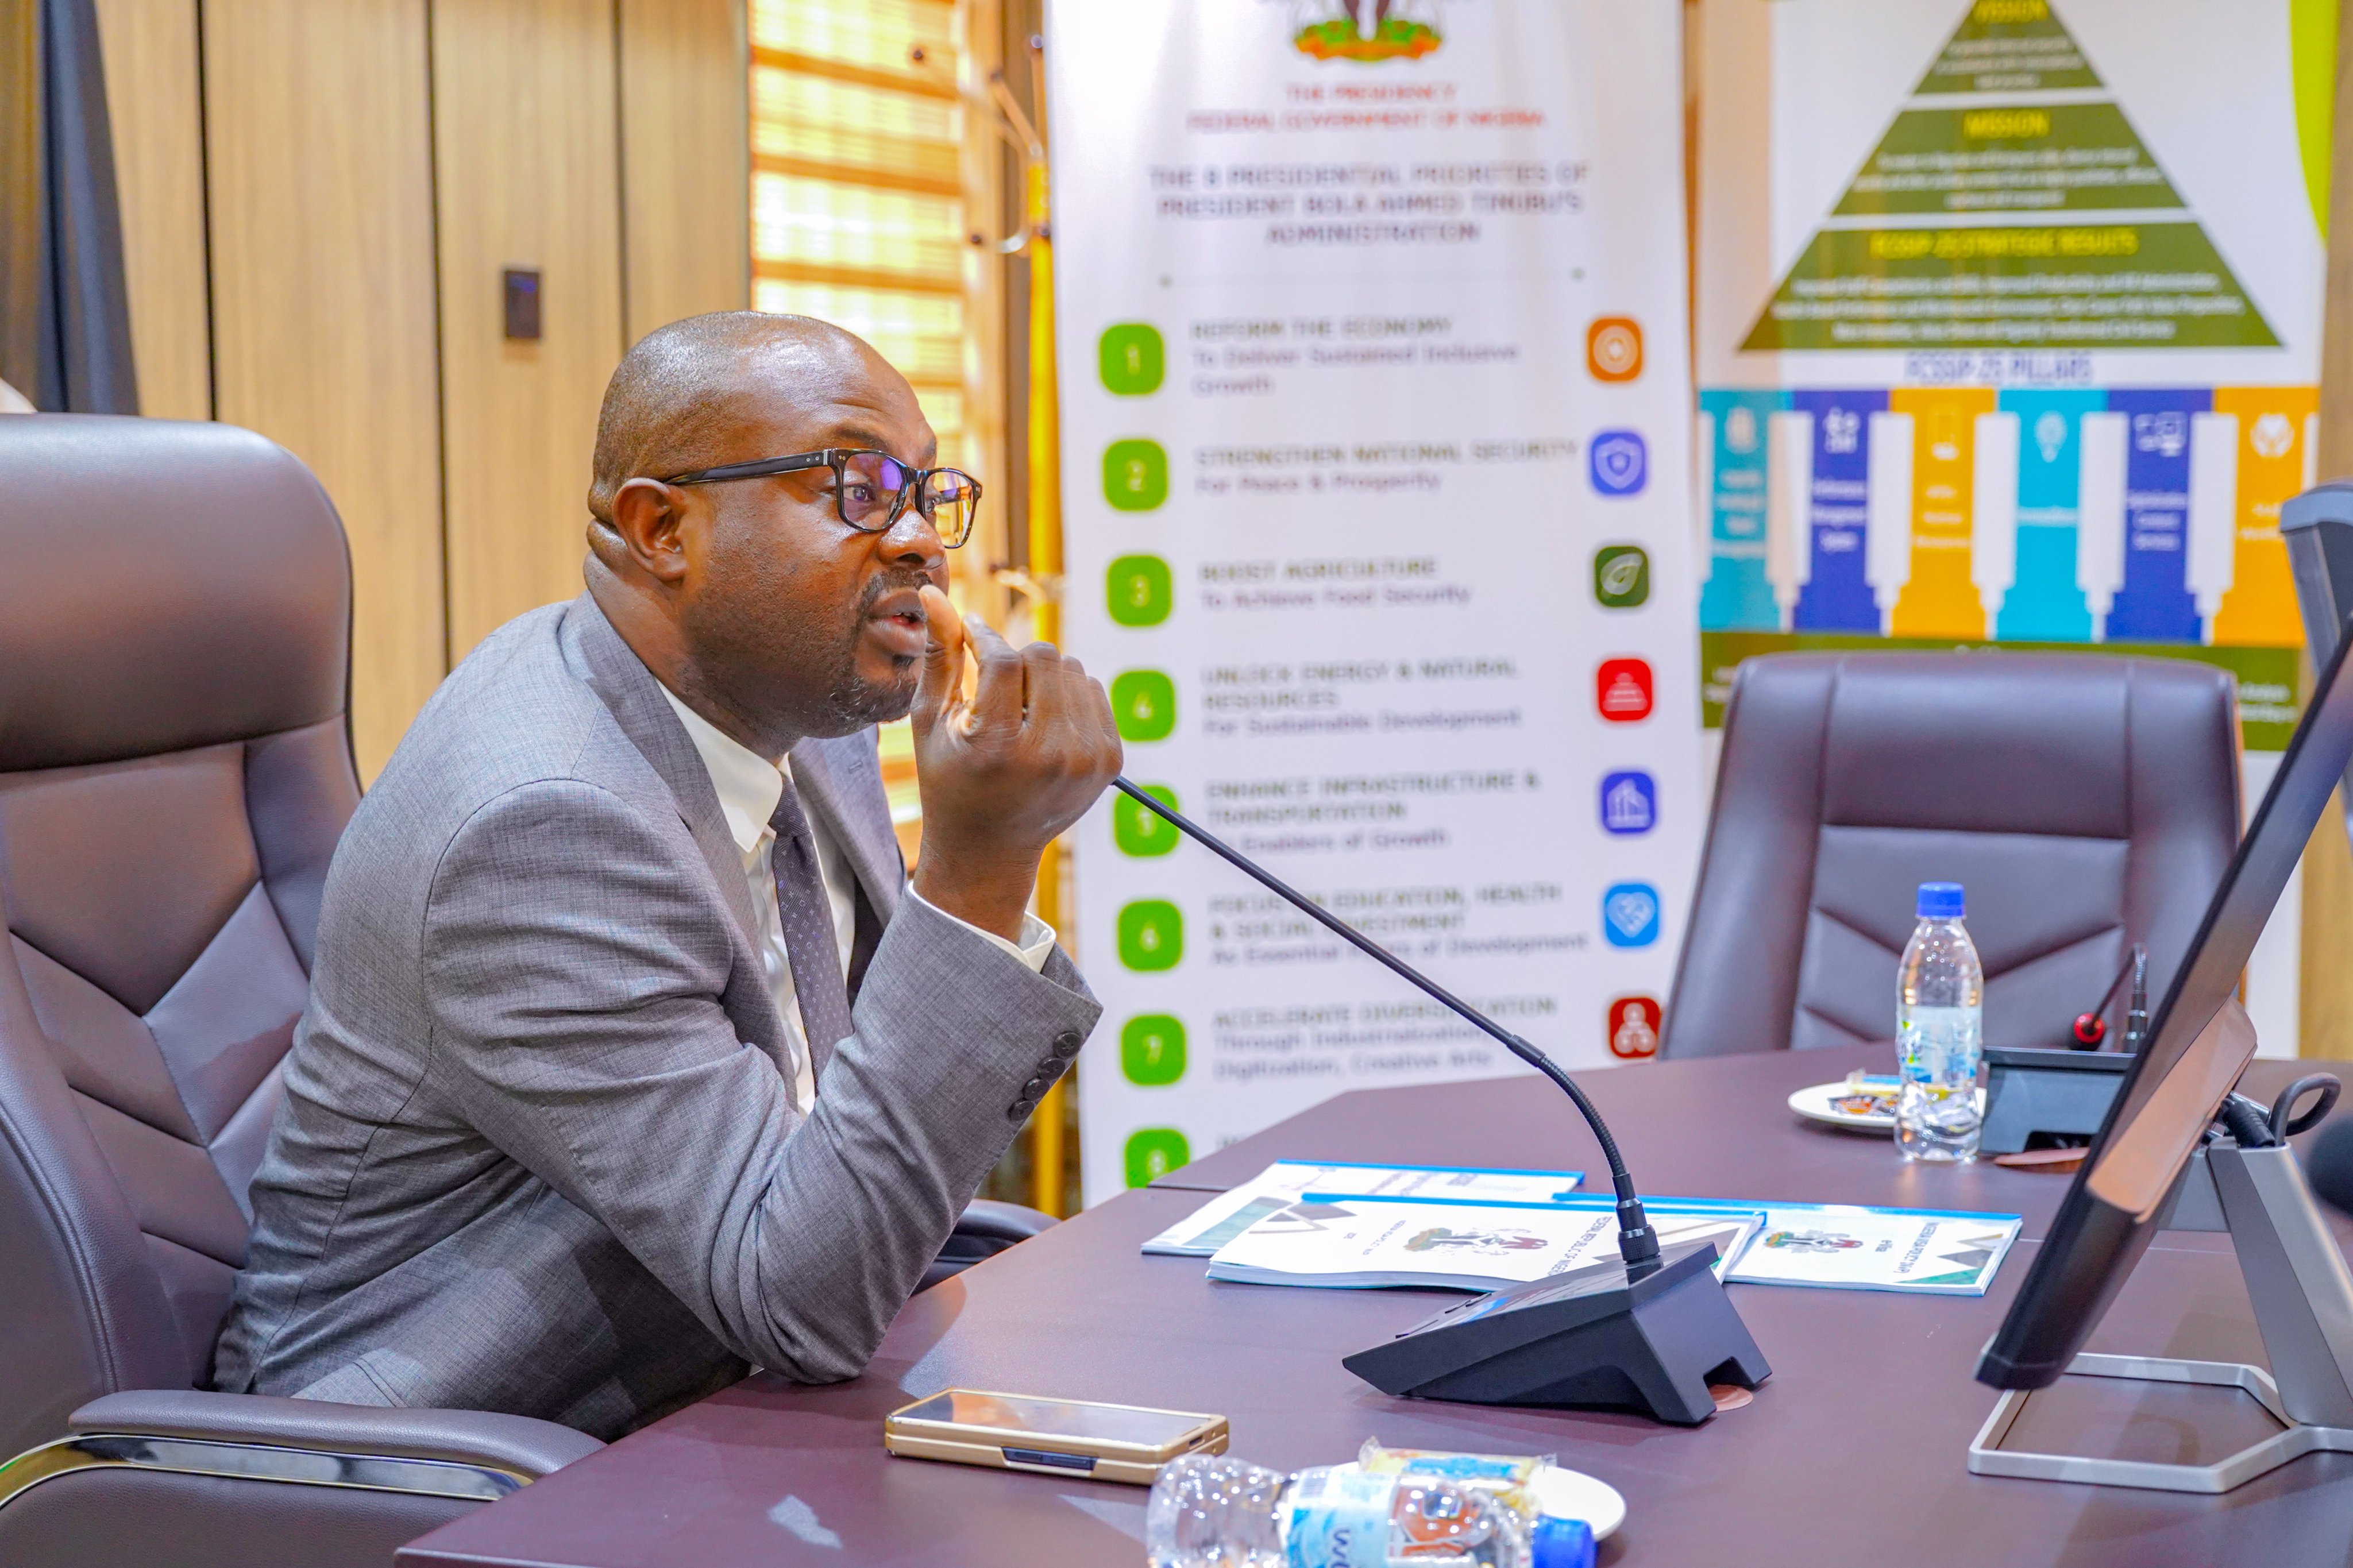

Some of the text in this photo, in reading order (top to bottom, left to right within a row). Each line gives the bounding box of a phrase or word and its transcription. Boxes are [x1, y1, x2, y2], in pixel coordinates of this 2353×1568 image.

[1151, 161, 1588, 187] THE 8 PRESIDENTIAL PRIORITIES OF
[1159, 194, 1293, 217] PRESIDENT
[1303, 194, 1367, 216] BOLA
[1378, 192, 1462, 215] AHMED
[1268, 222, 1479, 245] ADMINISTRATION
[1191, 316, 1450, 339] REFORM THE ECONOMY
[1124, 345, 1141, 374] 1
[1195, 344, 1518, 367] To Deliver Sustained Inclusive
[1193, 374, 1273, 395] Growth
[1195, 439, 1576, 467] STRENGTHEN NATIONAL SECURITY
[1127, 460, 1145, 491] 2
[1196, 474, 1229, 493] For
[1239, 473, 1298, 492] Peace
[1332, 472, 1440, 495] Prosperity
[1198, 556, 1437, 582] BOOST AGRICULTURE
[1130, 575, 1150, 606] 3
[1203, 586, 1470, 609] To Achieve Food Security
[1203, 665, 1290, 684] UNLOCK
[1301, 662, 1387, 682] ENERGY
[1418, 658, 1518, 679] NATURAL
[1132, 689, 1153, 719] 4
[1203, 691, 1338, 712] RESOURCES
[1204, 710, 1519, 734] For Sustainable Development
[1206, 778, 1308, 799] ENHANCE
[1321, 770, 1515, 794] INFRASTRUCTURE
[1209, 802, 1406, 825] TRANSPORTATION
[1243, 831, 1333, 852] Enablers
[1344, 831, 1363, 849] of
[1370, 828, 1448, 849] Growth
[1476, 885, 1561, 904] HEALTH
[1139, 922, 1159, 951] 6
[1236, 918, 1312, 937] SOCIAL
[1212, 948, 1235, 965] As
[1245, 945, 1337, 965] Essential
[1421, 940, 1441, 956] of
[1447, 934, 1586, 959] Development
[1213, 1005, 1349, 1028] ACCELERATE
[1144, 1035, 1164, 1064] 7
[1218, 1033, 1298, 1053] Through
[1351, 1052, 1439, 1075] Creative
[1448, 1051, 1489, 1069] Arts
